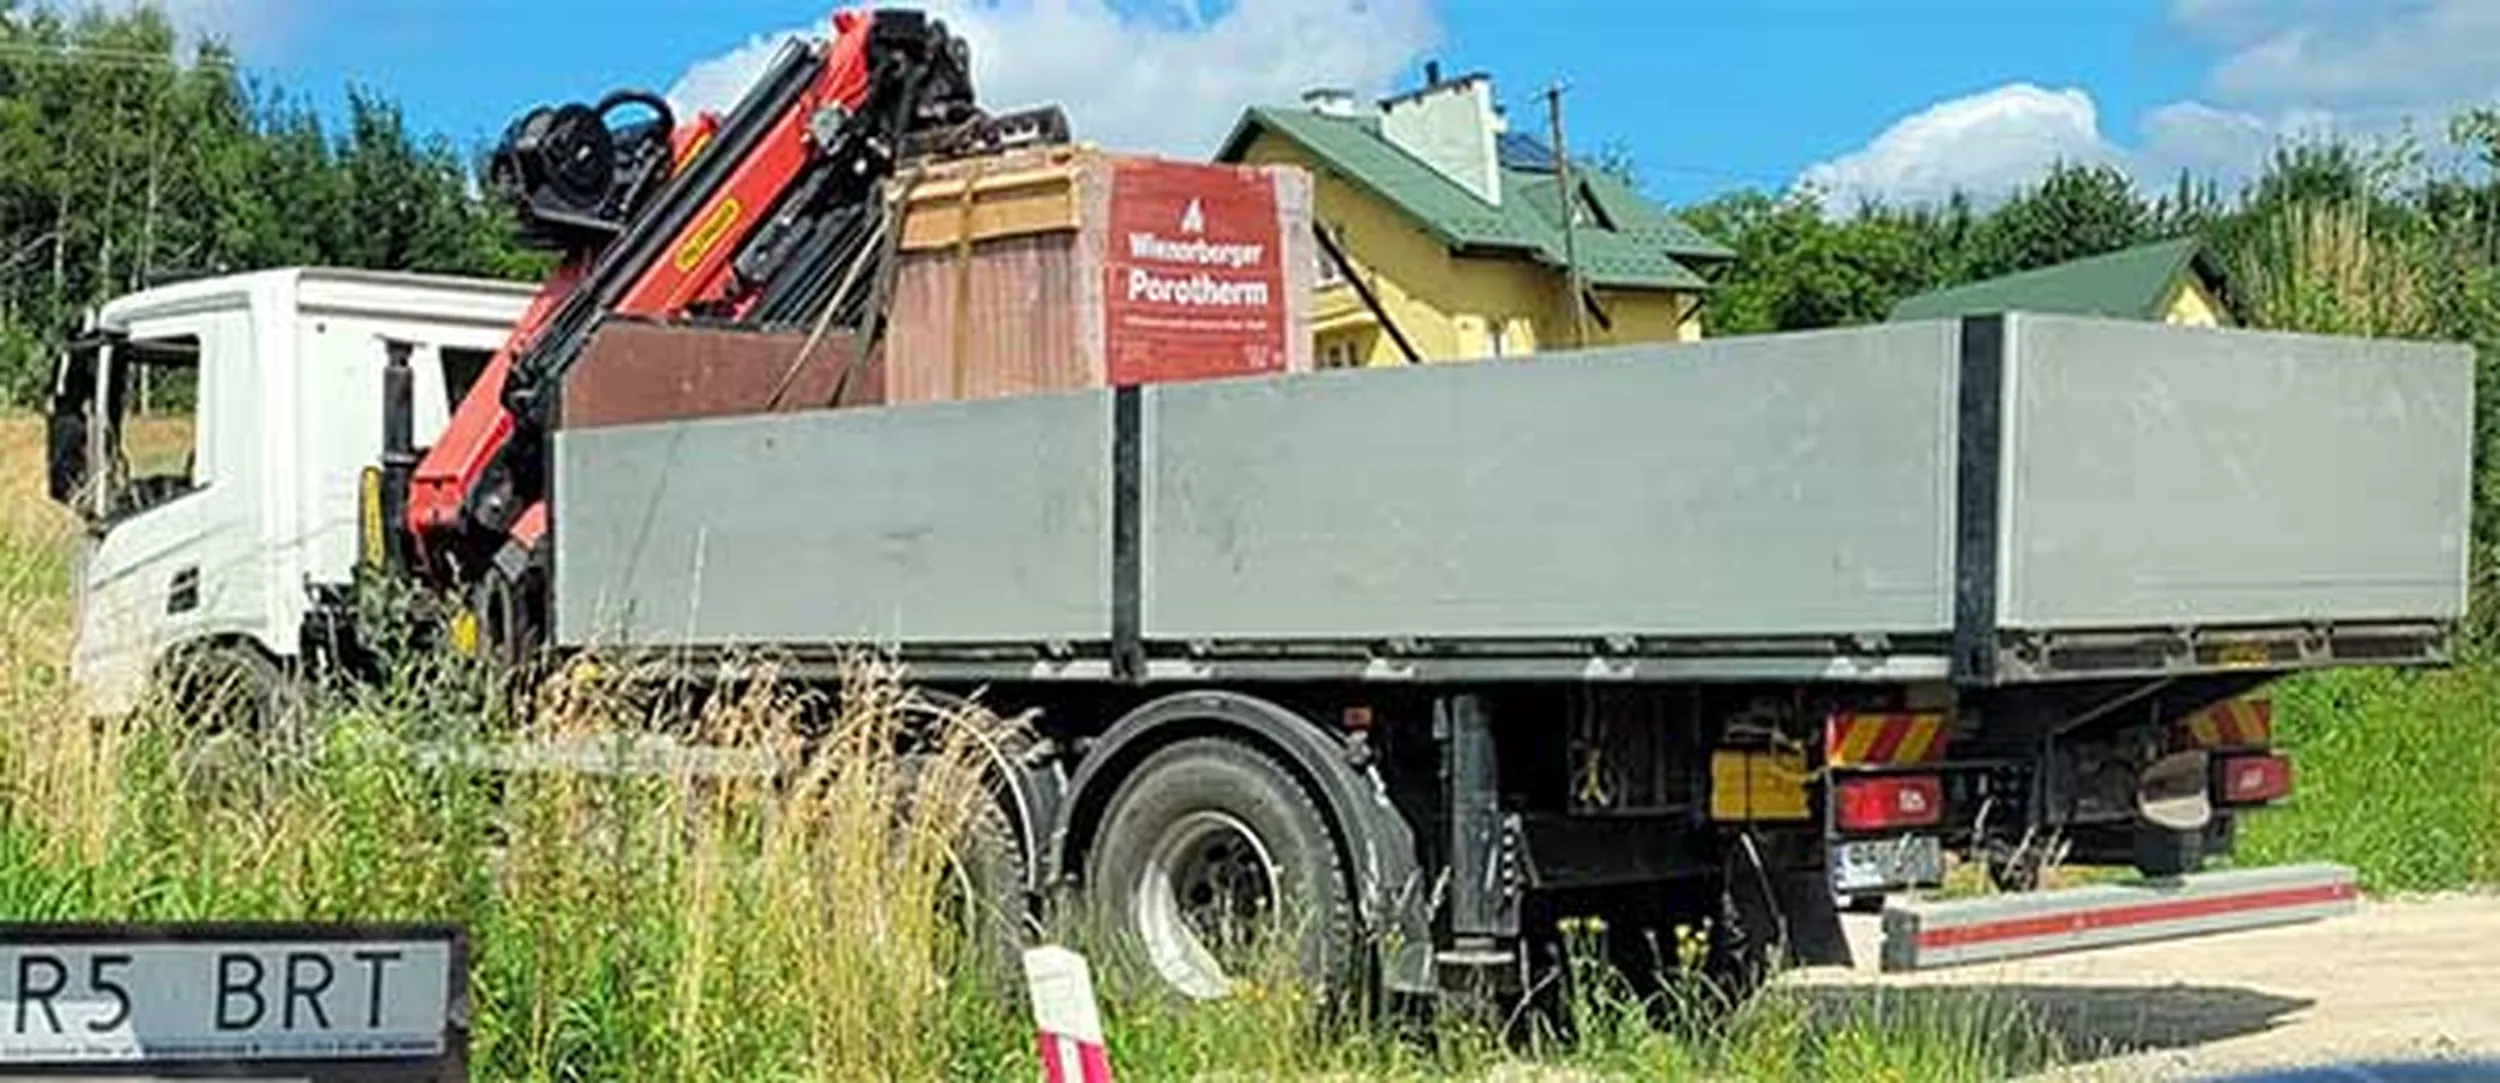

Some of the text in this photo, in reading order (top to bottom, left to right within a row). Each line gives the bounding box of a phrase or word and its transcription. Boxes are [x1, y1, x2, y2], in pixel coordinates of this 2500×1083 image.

[1128, 269, 1268, 304] Porotherm
[15, 952, 402, 1033] R5 BRT
